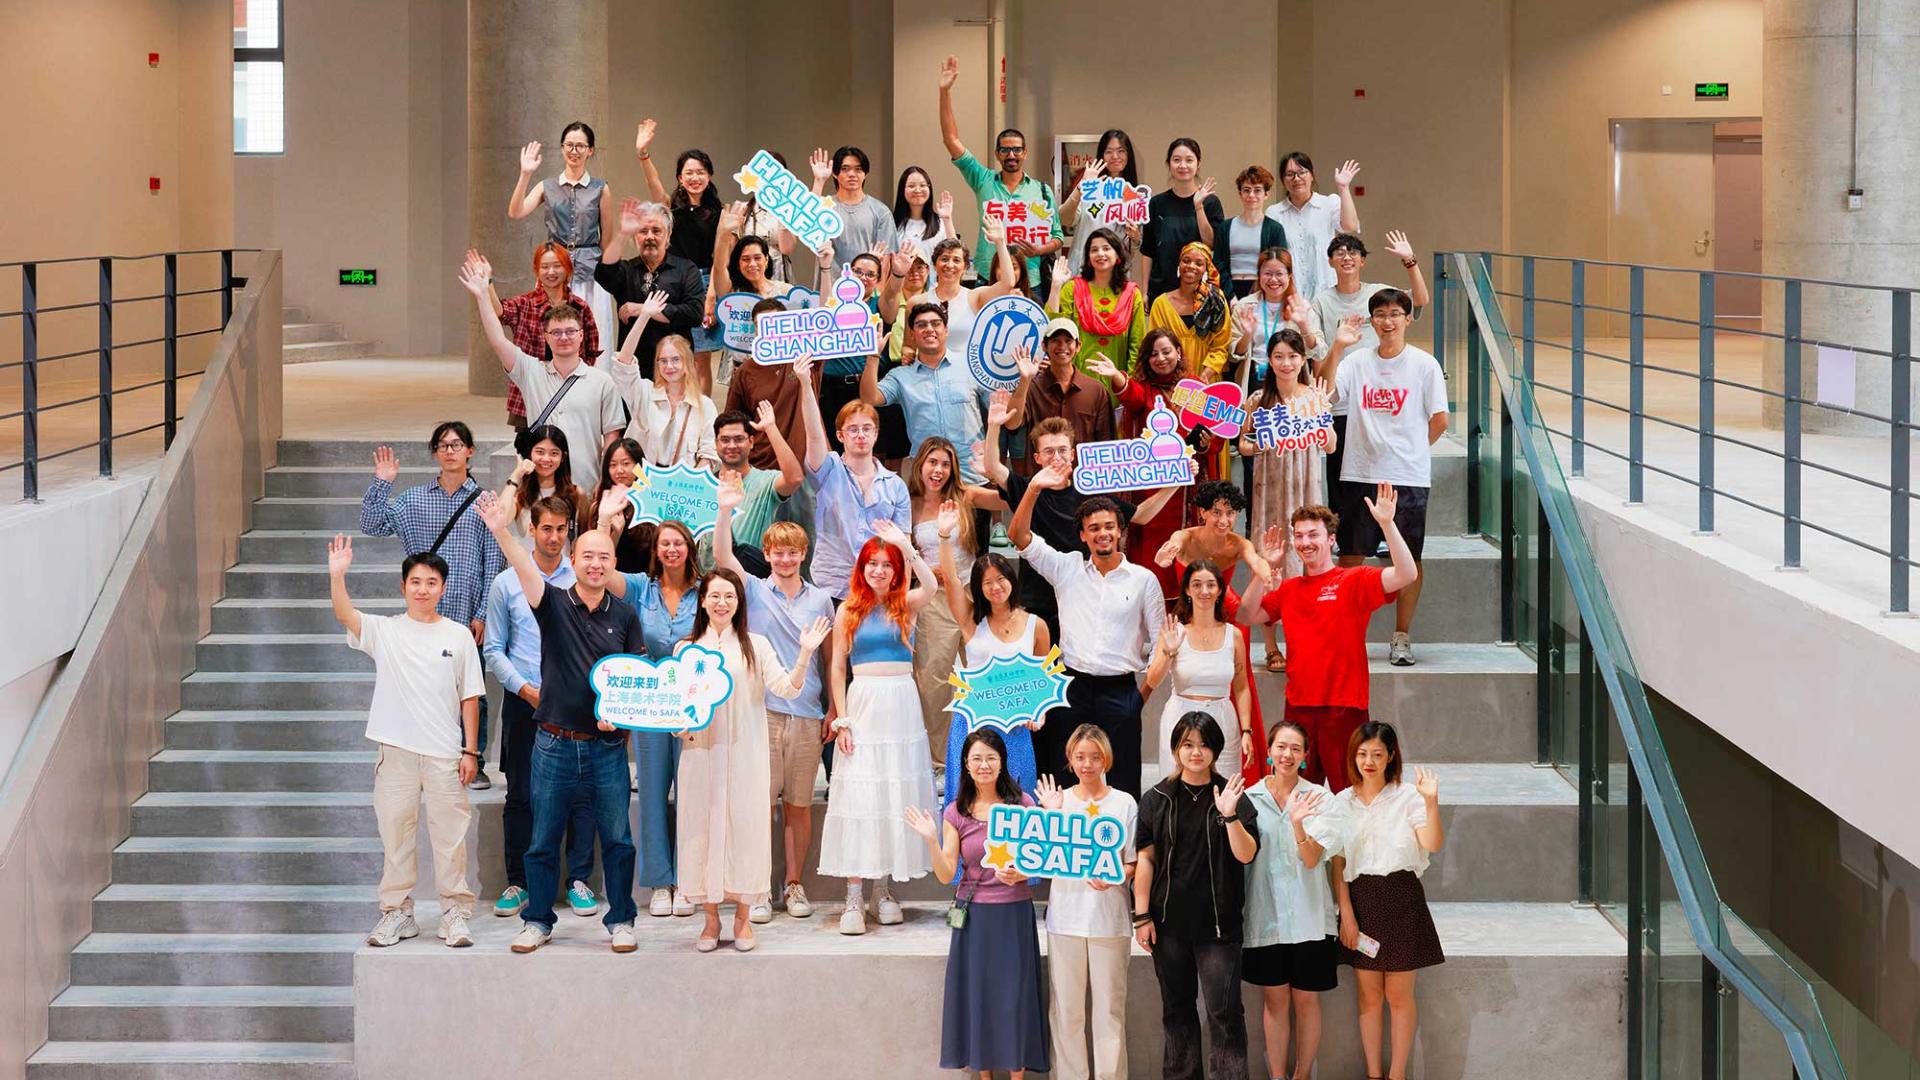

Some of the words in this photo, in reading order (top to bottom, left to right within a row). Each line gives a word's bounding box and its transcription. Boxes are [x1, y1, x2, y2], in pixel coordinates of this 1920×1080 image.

[753, 153, 840, 235] HALLO
[1082, 179, 1123, 201] 艺帆
[760, 185, 826, 252] SAFA
[986, 201, 1028, 222] 与美
[1105, 201, 1148, 224] 风顺
[1006, 226, 1050, 245] 同行
[764, 314, 832, 336] HELLO
[759, 329, 871, 358] SHANGHAI
[969, 343, 993, 386] SHANGHAI
[1276, 428, 1328, 456] young
[1084, 443, 1148, 466] HELLO
[1080, 461, 1187, 487] SHANGHAI
[651, 490, 703, 508] WELCOME
[705, 500, 718, 511] TO
[667, 506, 697, 520] SAFA
[606, 675, 659, 689] 欢迎来到
[974, 683, 1030, 701] WELCOME
[1032, 679, 1047, 690] TO
[604, 690, 682, 706] 上海美术学院
[999, 696, 1030, 710] SAFA
[605, 706, 647, 716] WELCOME
[649, 709, 657, 717] to
[659, 709, 680, 717] SAFA
[994, 811, 1120, 847] HALLO
[1020, 842, 1118, 878] SAFA
